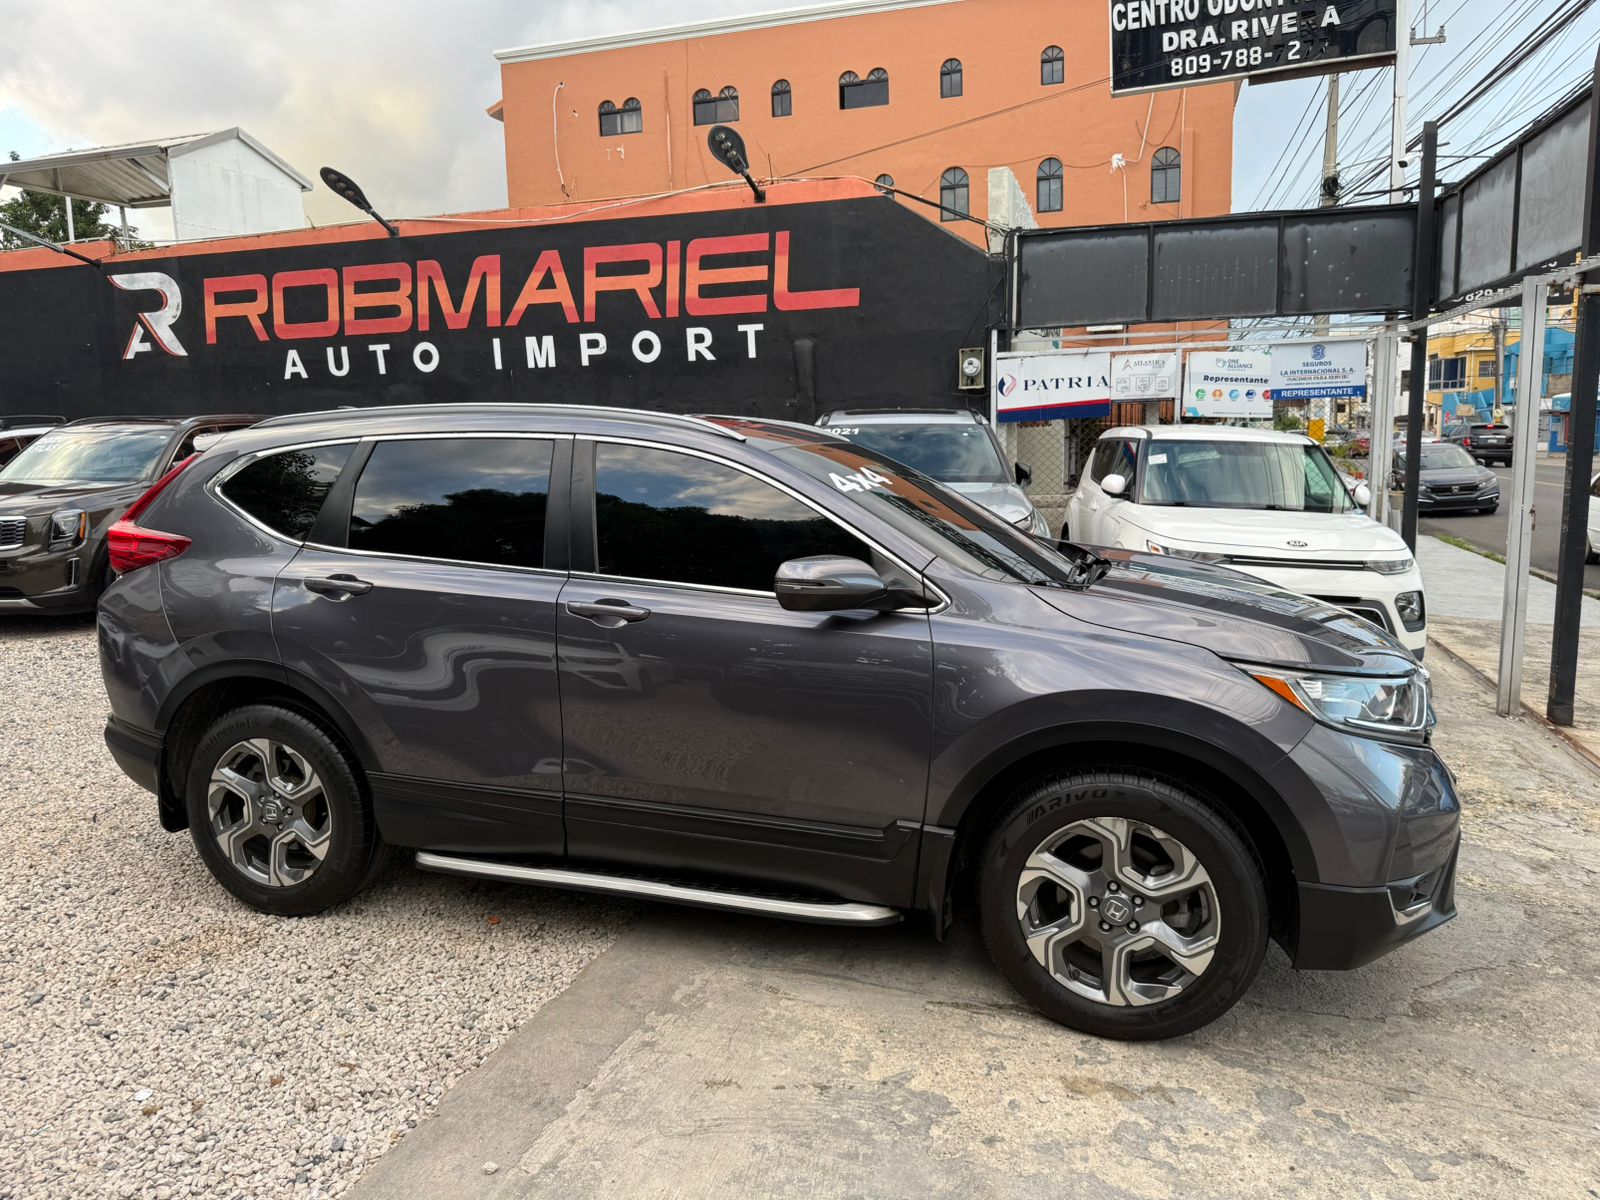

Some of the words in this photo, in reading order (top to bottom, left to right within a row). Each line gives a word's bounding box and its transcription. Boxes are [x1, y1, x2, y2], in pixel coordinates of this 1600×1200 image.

[1112, 0, 1199, 31] CENTRO
[1162, 26, 1226, 53] DRA.
[203, 230, 861, 345] ROBMARIEL
[283, 341, 440, 380] AUTO
[492, 323, 765, 370] IMPORT
[1023, 375, 1112, 391] PATRIA
[1203, 374, 1269, 385] Representante
[1281, 388, 1354, 397] REPRESENTANTE
